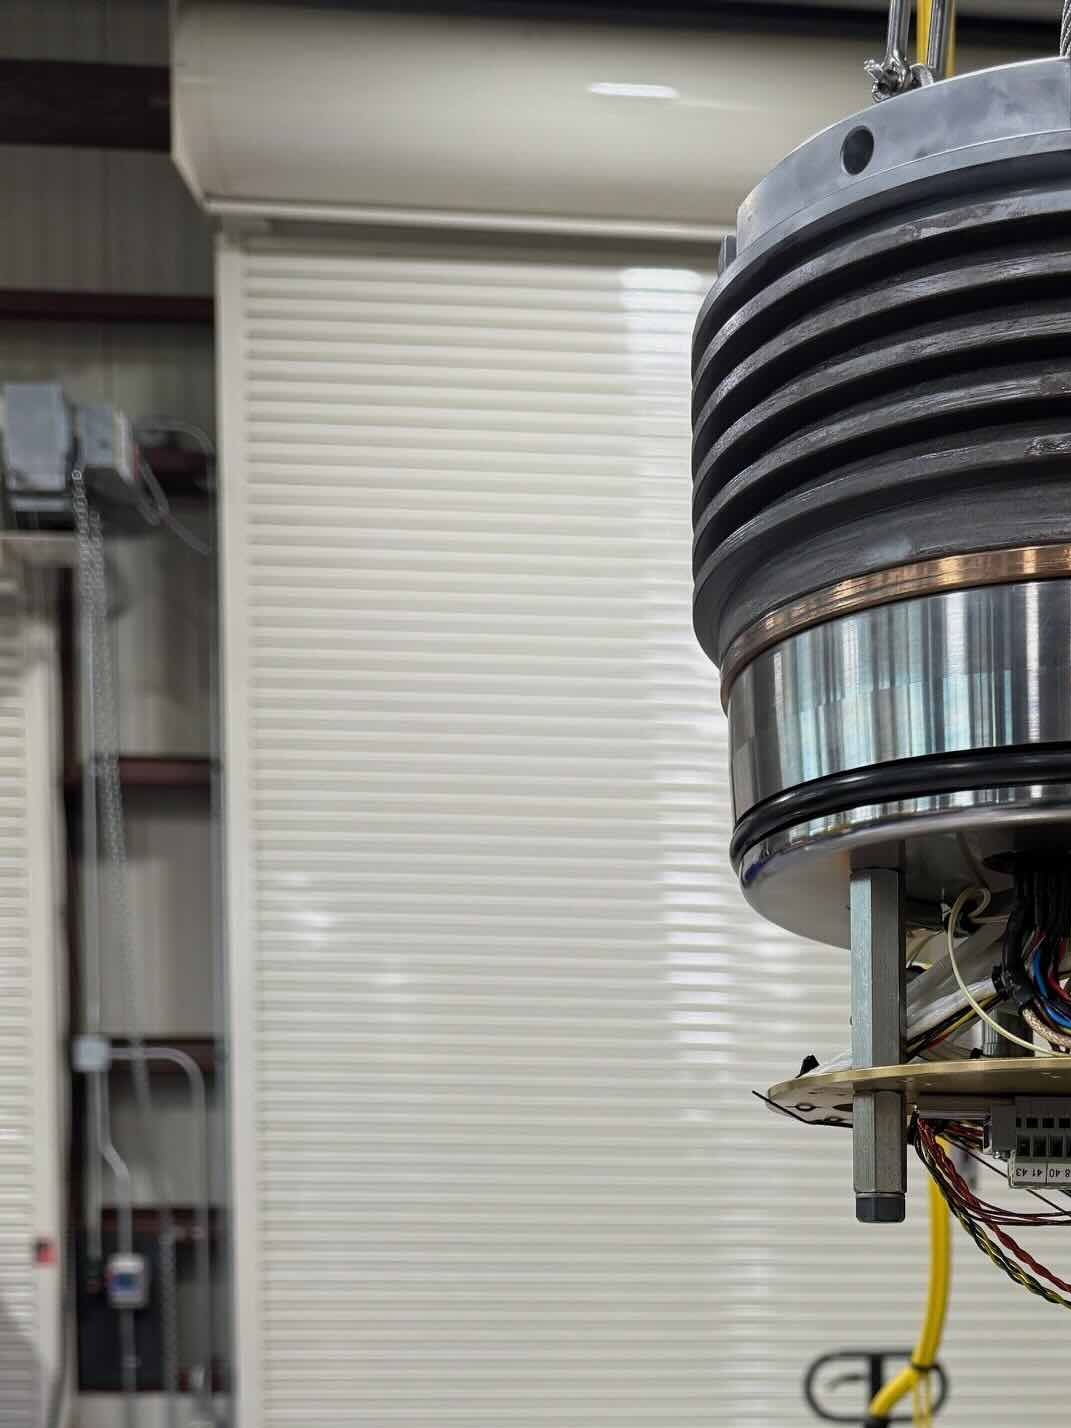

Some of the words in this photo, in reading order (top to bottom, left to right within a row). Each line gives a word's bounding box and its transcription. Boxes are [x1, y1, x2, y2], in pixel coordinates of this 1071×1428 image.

[1015, 1168, 1027, 1177] 43
[1032, 1168, 1042, 1177] 41
[1049, 1168, 1060, 1178] 40
